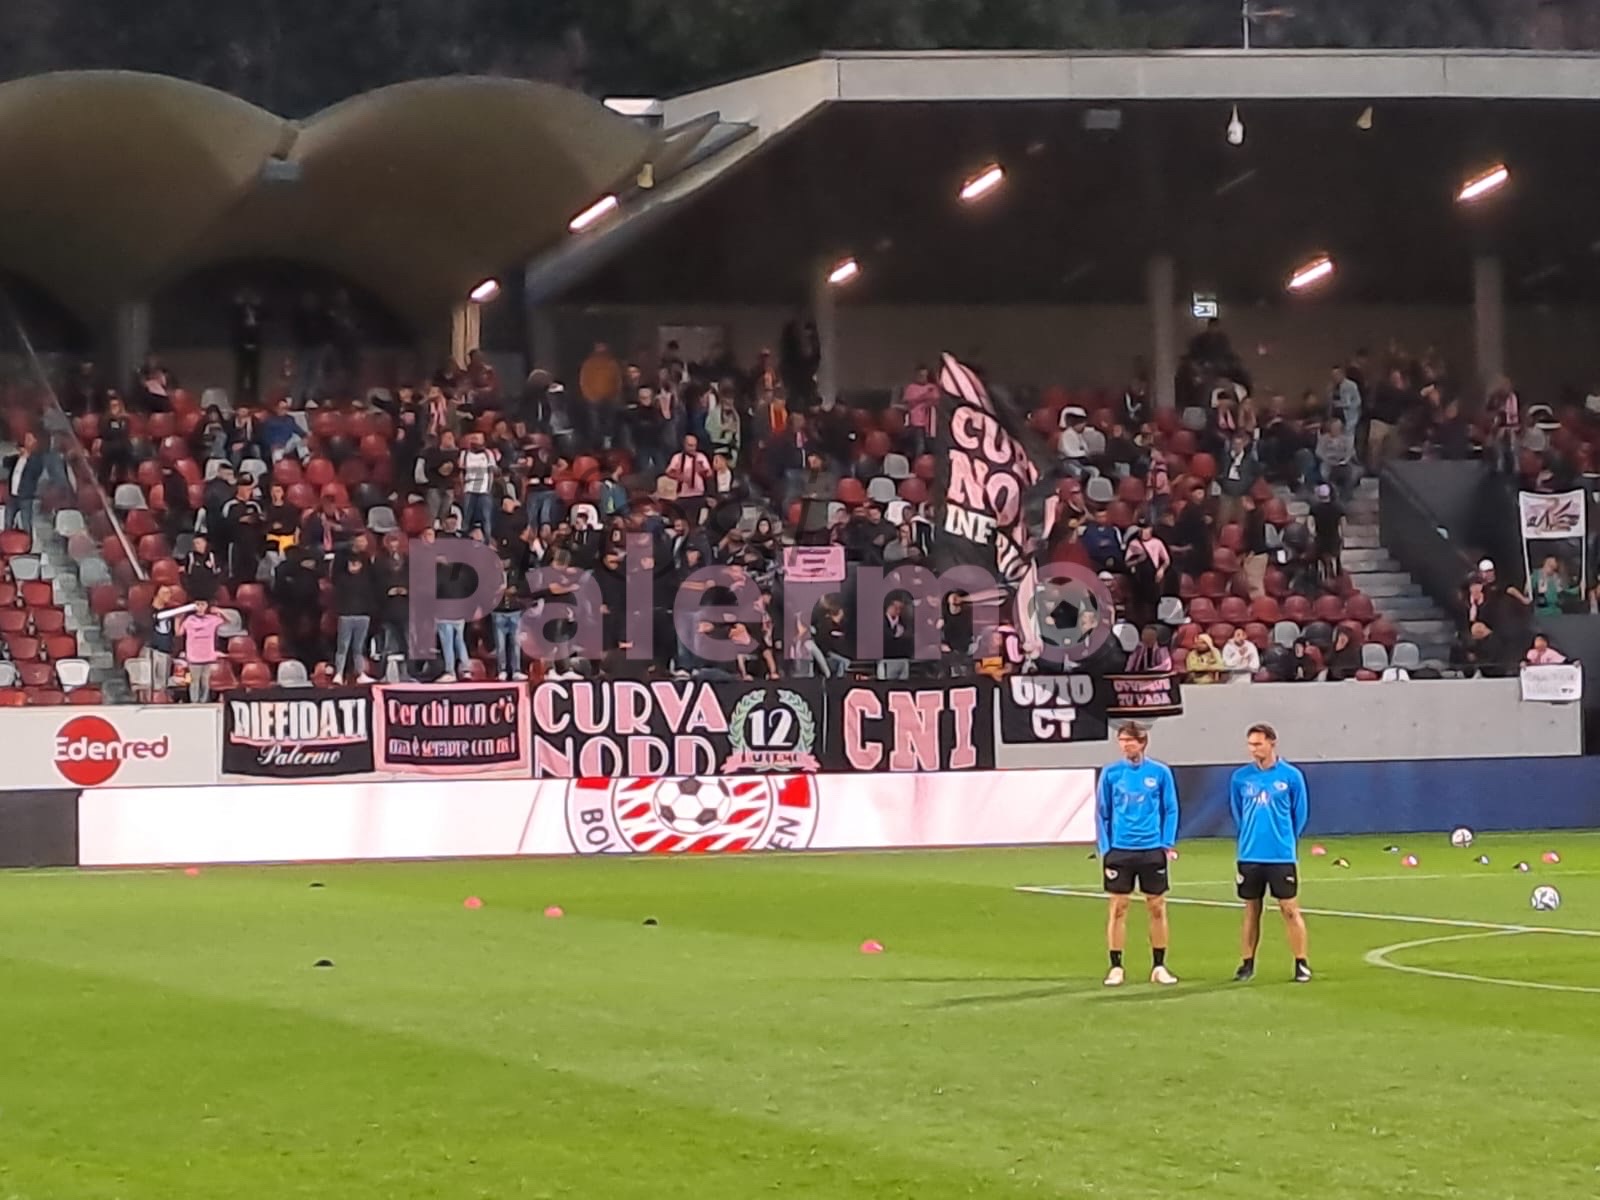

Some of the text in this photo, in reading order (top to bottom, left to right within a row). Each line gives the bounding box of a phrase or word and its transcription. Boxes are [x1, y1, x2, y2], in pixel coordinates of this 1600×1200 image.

[533, 681, 728, 734] CURVA
[1010, 674, 1094, 706] ODIO
[229, 698, 367, 740] DIFFIDATI
[388, 699, 418, 726] Per
[422, 699, 449, 726] chi
[453, 703, 486, 726] non
[748, 707, 794, 747] 12
[843, 687, 977, 770] CNI
[1032, 708, 1076, 738] CT
[54, 735, 169, 761] Edenred
[256, 743, 341, 765] Palermo
[534, 734, 716, 777] NORD
[763, 815, 801, 850] EN
